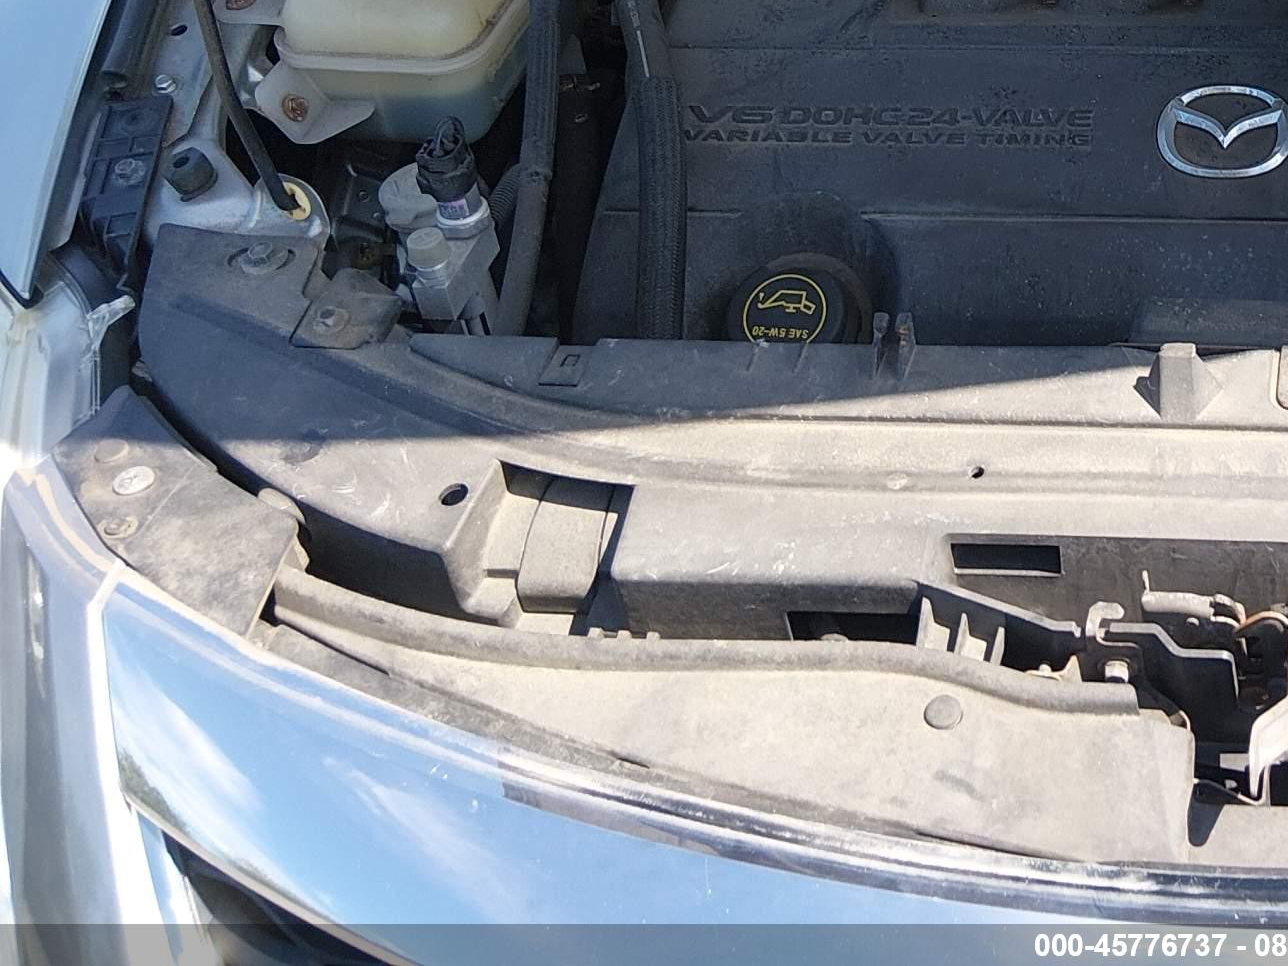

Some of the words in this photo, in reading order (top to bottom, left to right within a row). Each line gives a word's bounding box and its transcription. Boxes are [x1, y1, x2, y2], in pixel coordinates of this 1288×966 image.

[687, 105, 774, 124] V6
[779, 106, 901, 126] DOHC
[905, 108, 1094, 128] 24-VALVE
[683, 129, 853, 144] VARIABLE
[862, 130, 968, 146] VALVE
[977, 132, 1092, 147] TIMING
[752, 325, 786, 338] 5W-20
[787, 328, 809, 339] SAE
